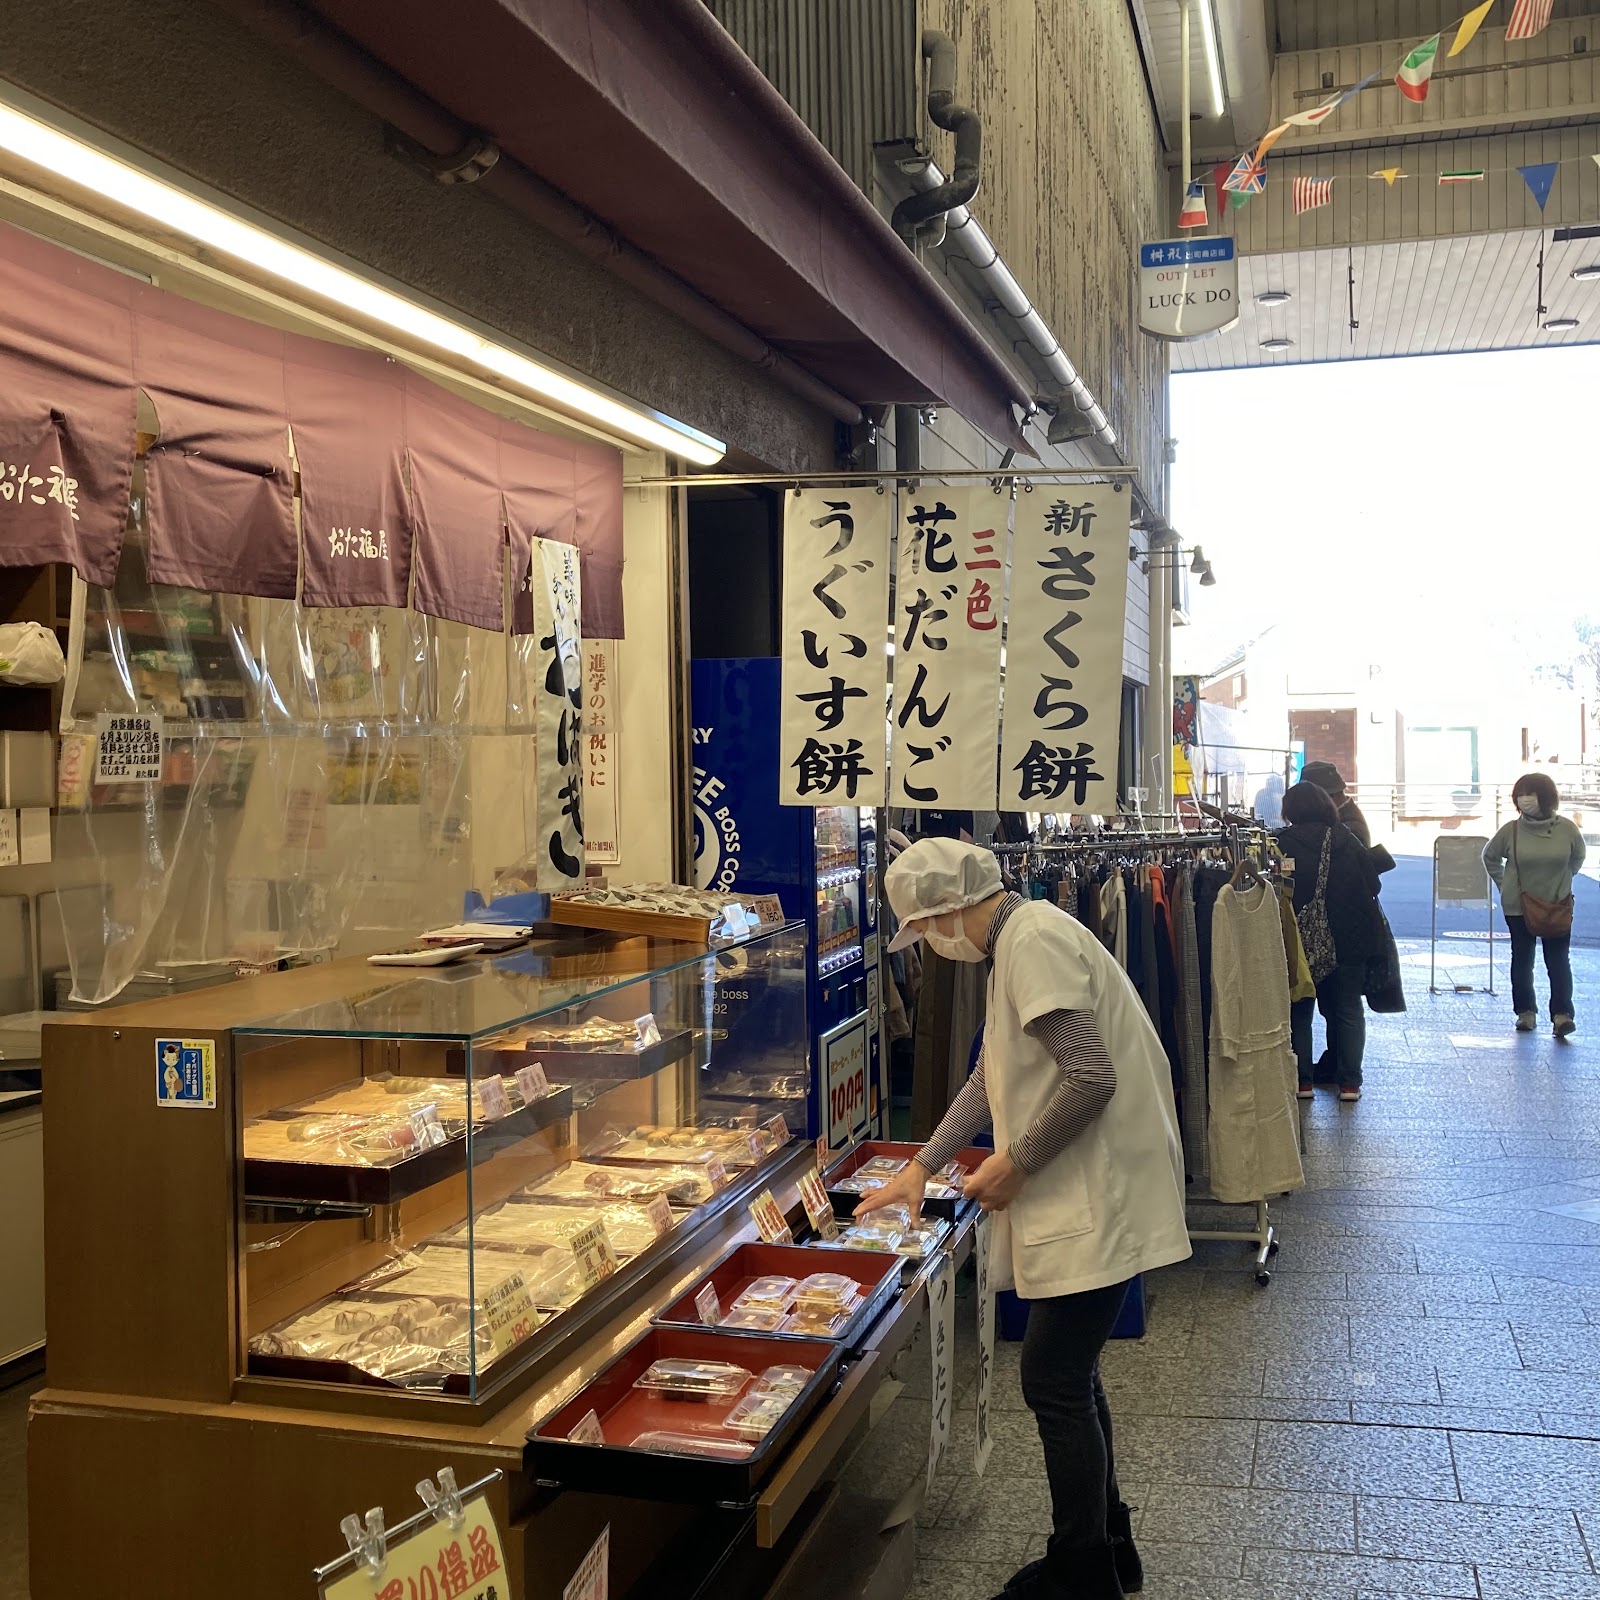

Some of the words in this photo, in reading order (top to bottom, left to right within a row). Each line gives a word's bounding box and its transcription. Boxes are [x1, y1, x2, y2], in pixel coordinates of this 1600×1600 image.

[1156, 271, 1182, 281] OUT
[1193, 268, 1216, 278] LET
[1149, 292, 1197, 308] LUCK
[1205, 288, 1231, 303] DO
[328, 527, 389, 560] おた福屋
[965, 528, 1001, 630] 三色
[790, 500, 875, 799] うぐいす餅
[898, 502, 958, 801] 花だんご
[714, 806, 741, 852] BOSS
[721, 989, 749, 1000] boss
[831, 1068, 864, 1129] 100円
